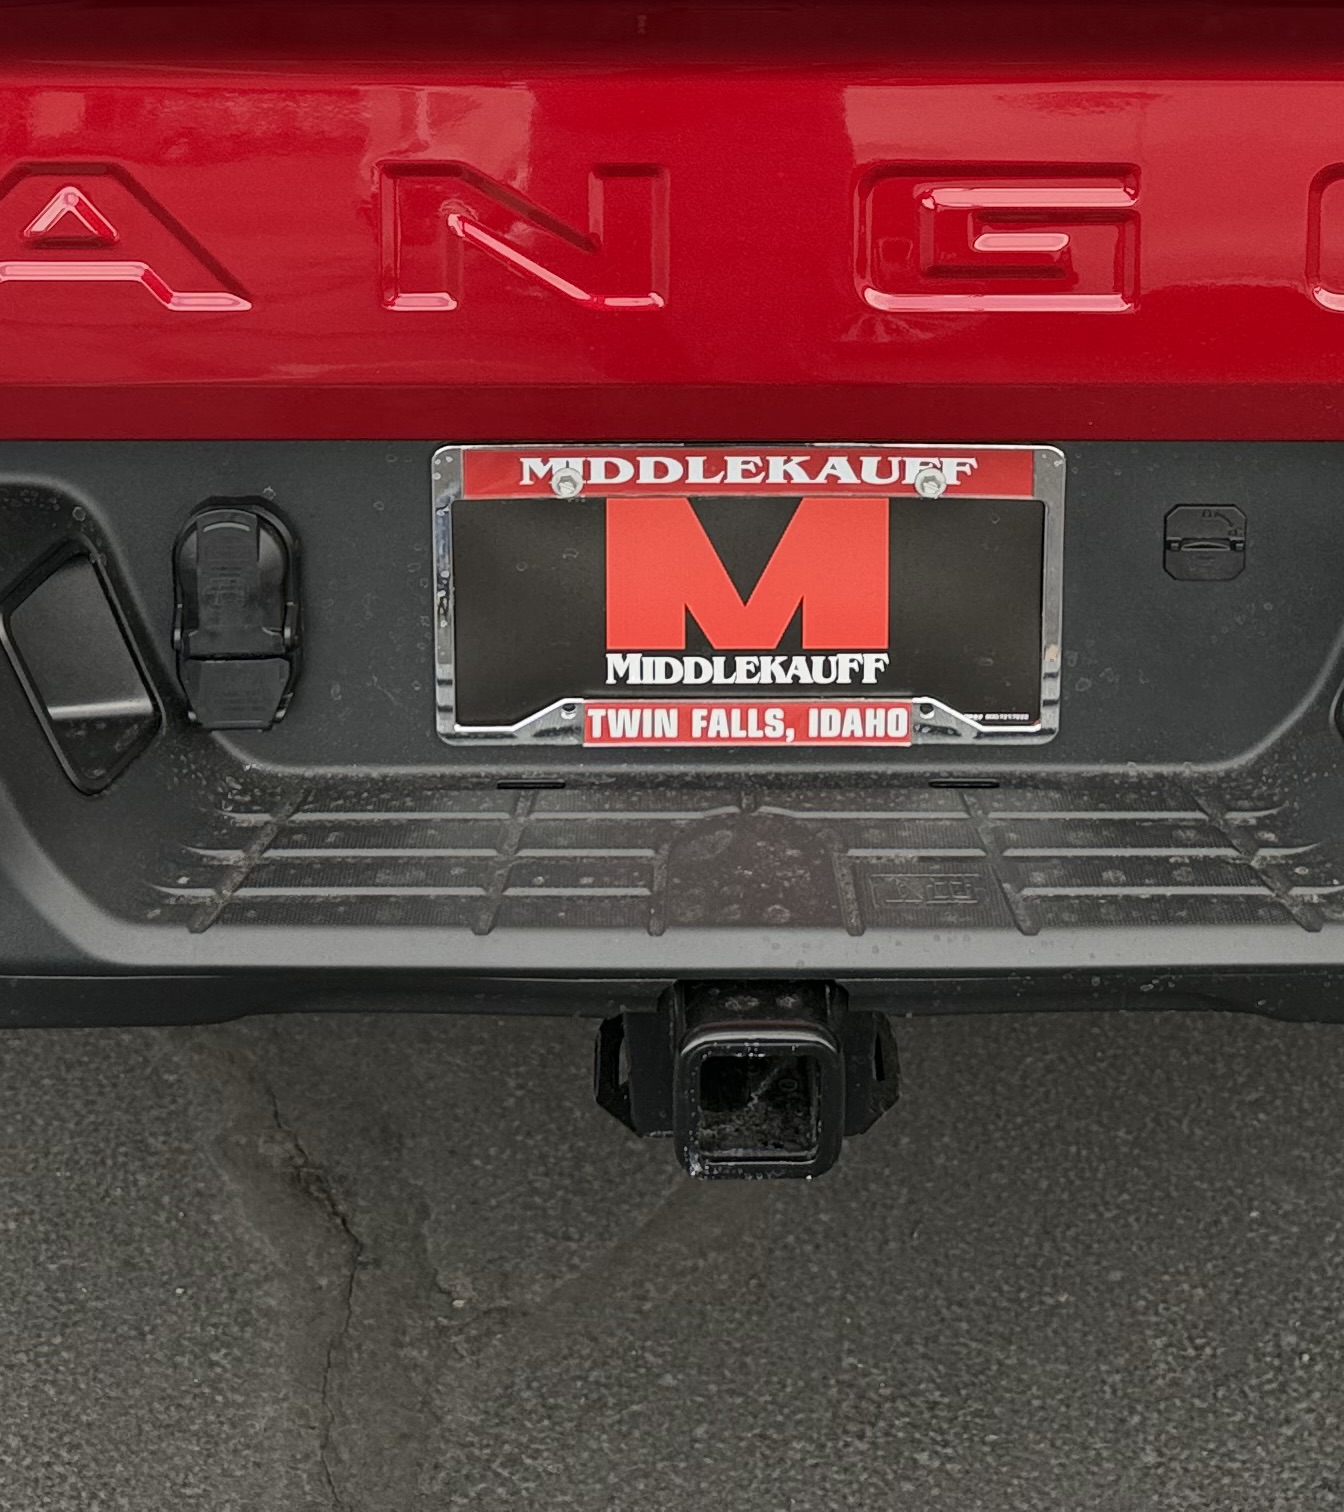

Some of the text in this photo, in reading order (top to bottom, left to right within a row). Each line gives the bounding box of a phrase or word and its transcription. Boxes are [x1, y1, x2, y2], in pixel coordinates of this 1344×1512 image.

[606, 498, 889, 649] M
[606, 653, 890, 685] MIDDLEKAUFF
[587, 707, 910, 742] TWIN FALLS, IDAHO
